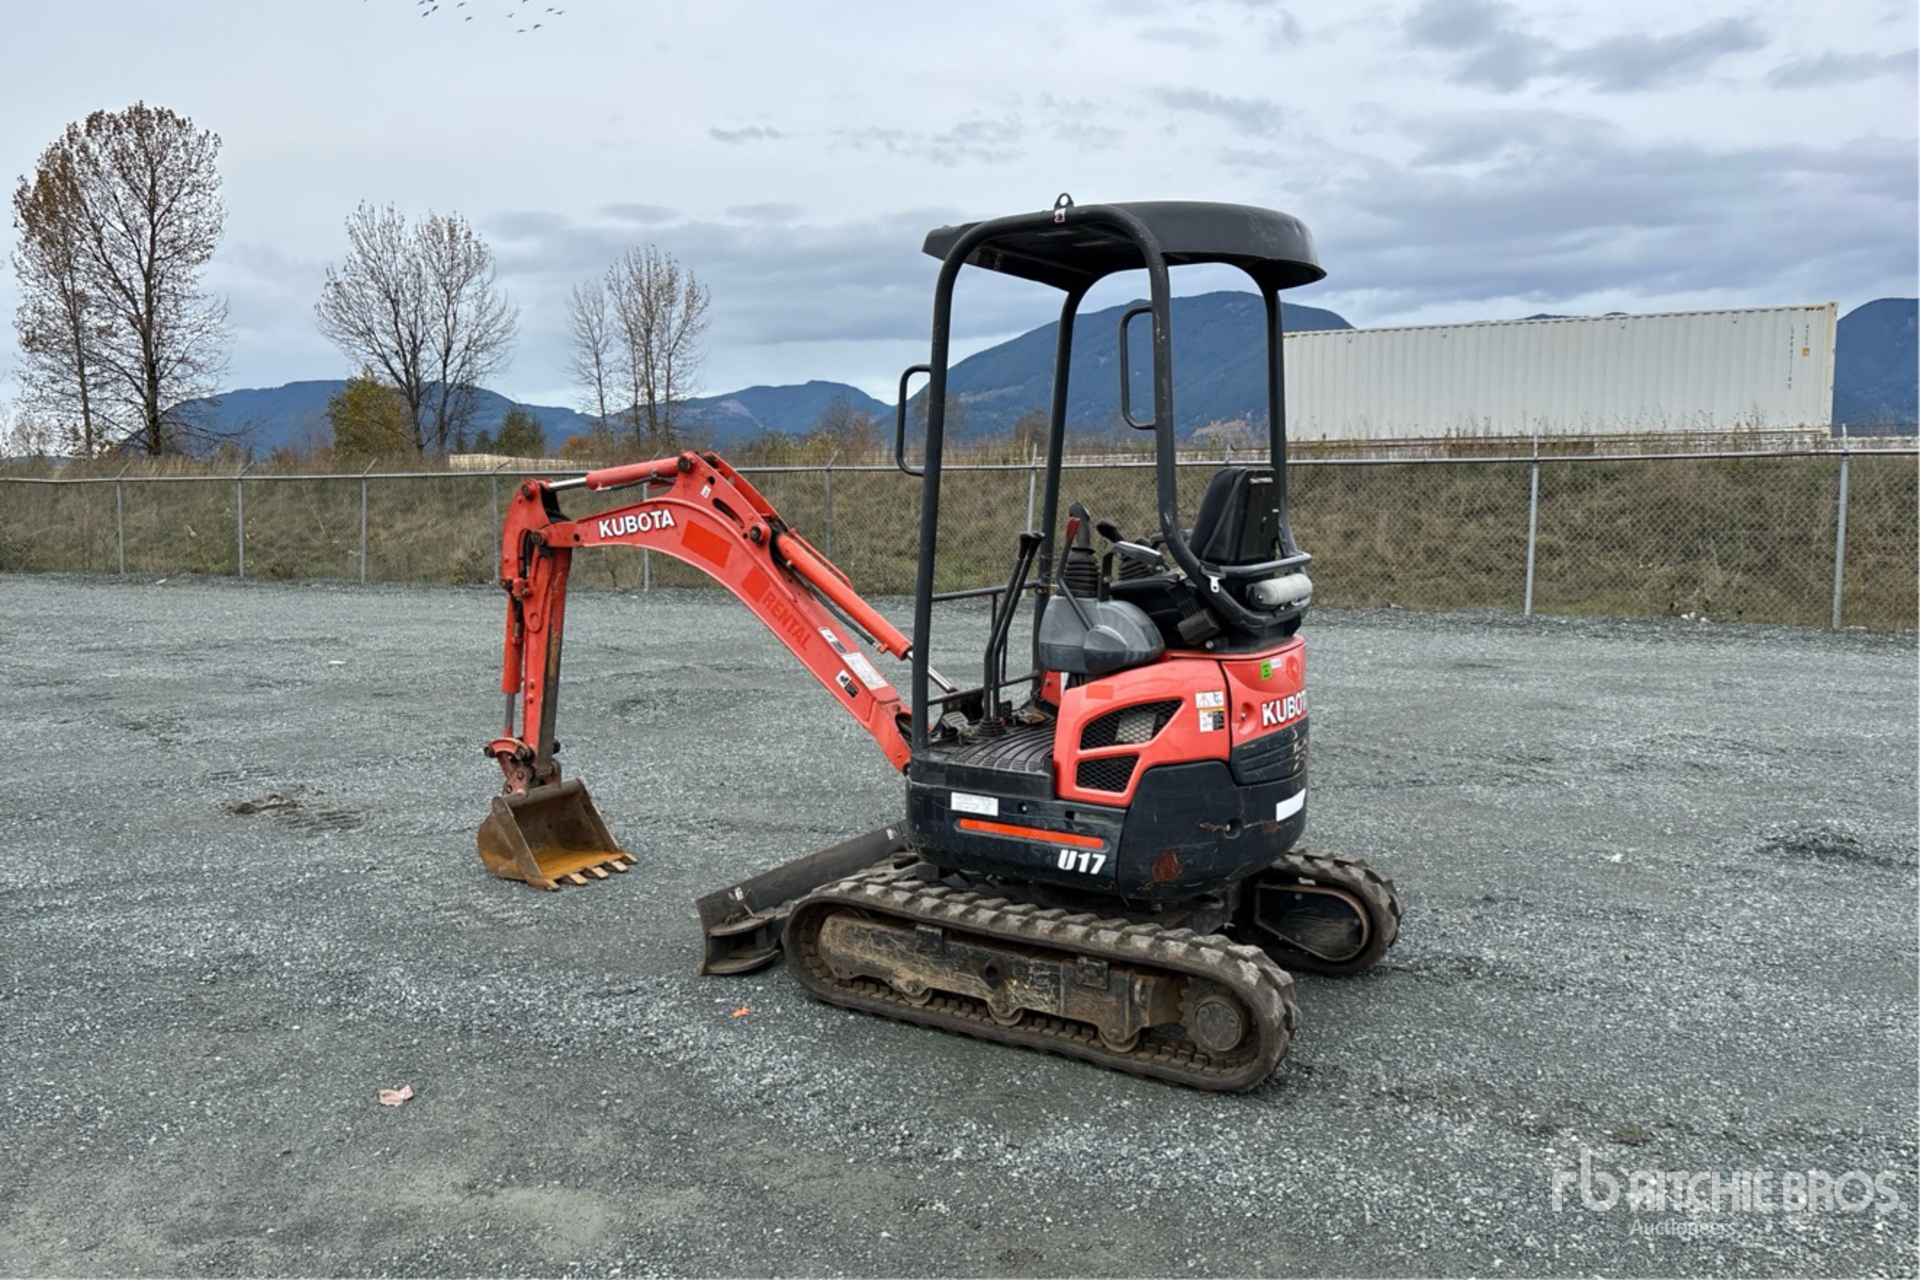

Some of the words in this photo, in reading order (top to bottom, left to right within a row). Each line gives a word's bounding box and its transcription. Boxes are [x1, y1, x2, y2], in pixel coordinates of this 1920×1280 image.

[598, 508, 677, 538] KUBOTA
[762, 590, 812, 652] RENTAL
[1261, 689, 1306, 727] KUBOT
[1057, 850, 1107, 875] U17
